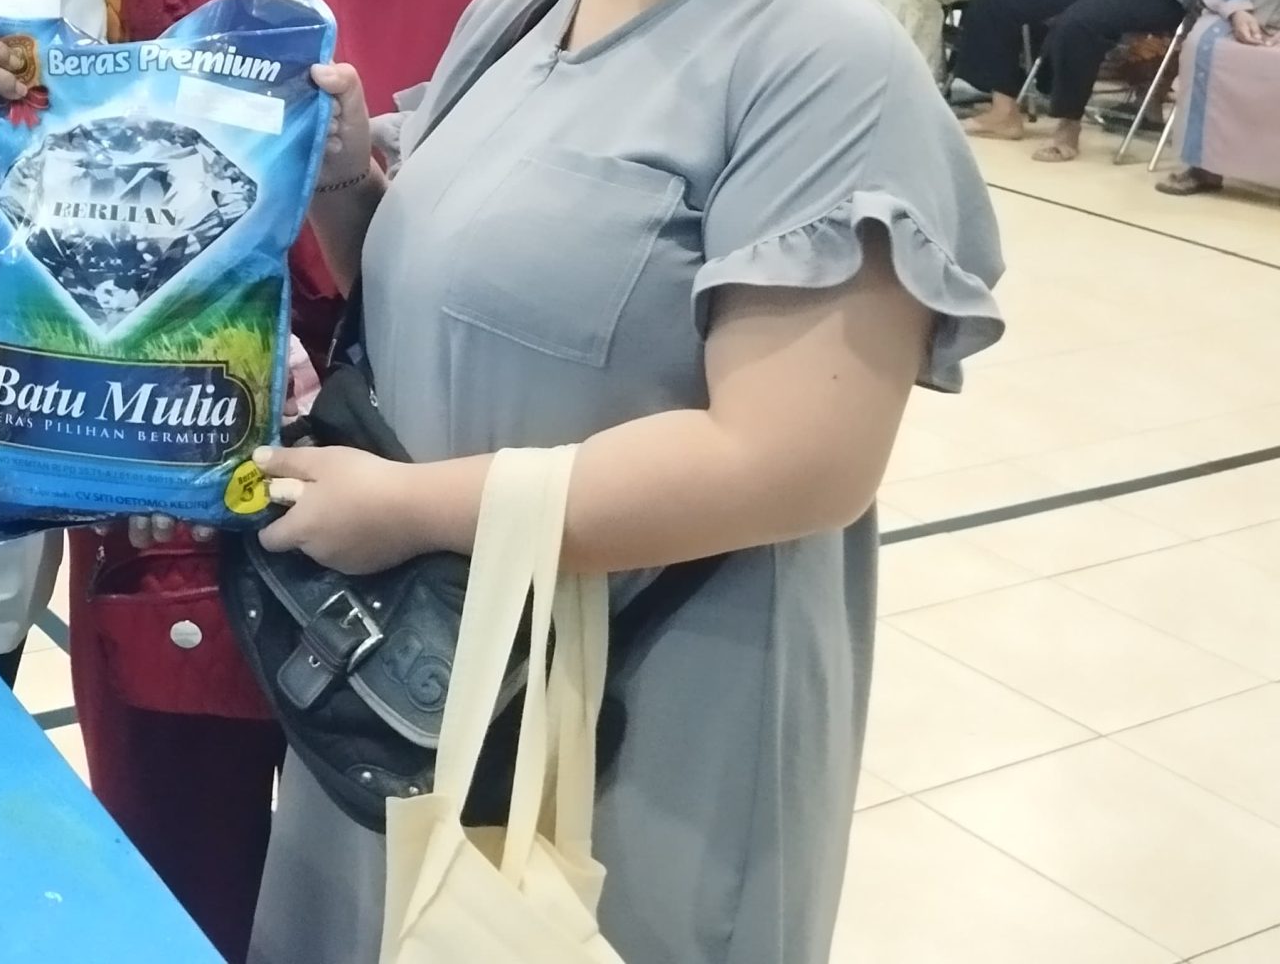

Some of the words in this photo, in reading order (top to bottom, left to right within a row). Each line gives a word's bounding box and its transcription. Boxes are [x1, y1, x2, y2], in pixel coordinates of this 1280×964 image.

[48, 48, 130, 76] Beras
[139, 43, 282, 83] Premium
[53, 201, 177, 226] BERLIAN
[94, 380, 239, 428] Mulia
[44, 419, 125, 440] PILIHAN
[137, 429, 230, 445] BERMUTU
[75, 491, 91, 501] CV
[93, 492, 114, 503] SITI
[170, 499, 209, 510] KEDIRI
[240, 481, 254, 502] 5
